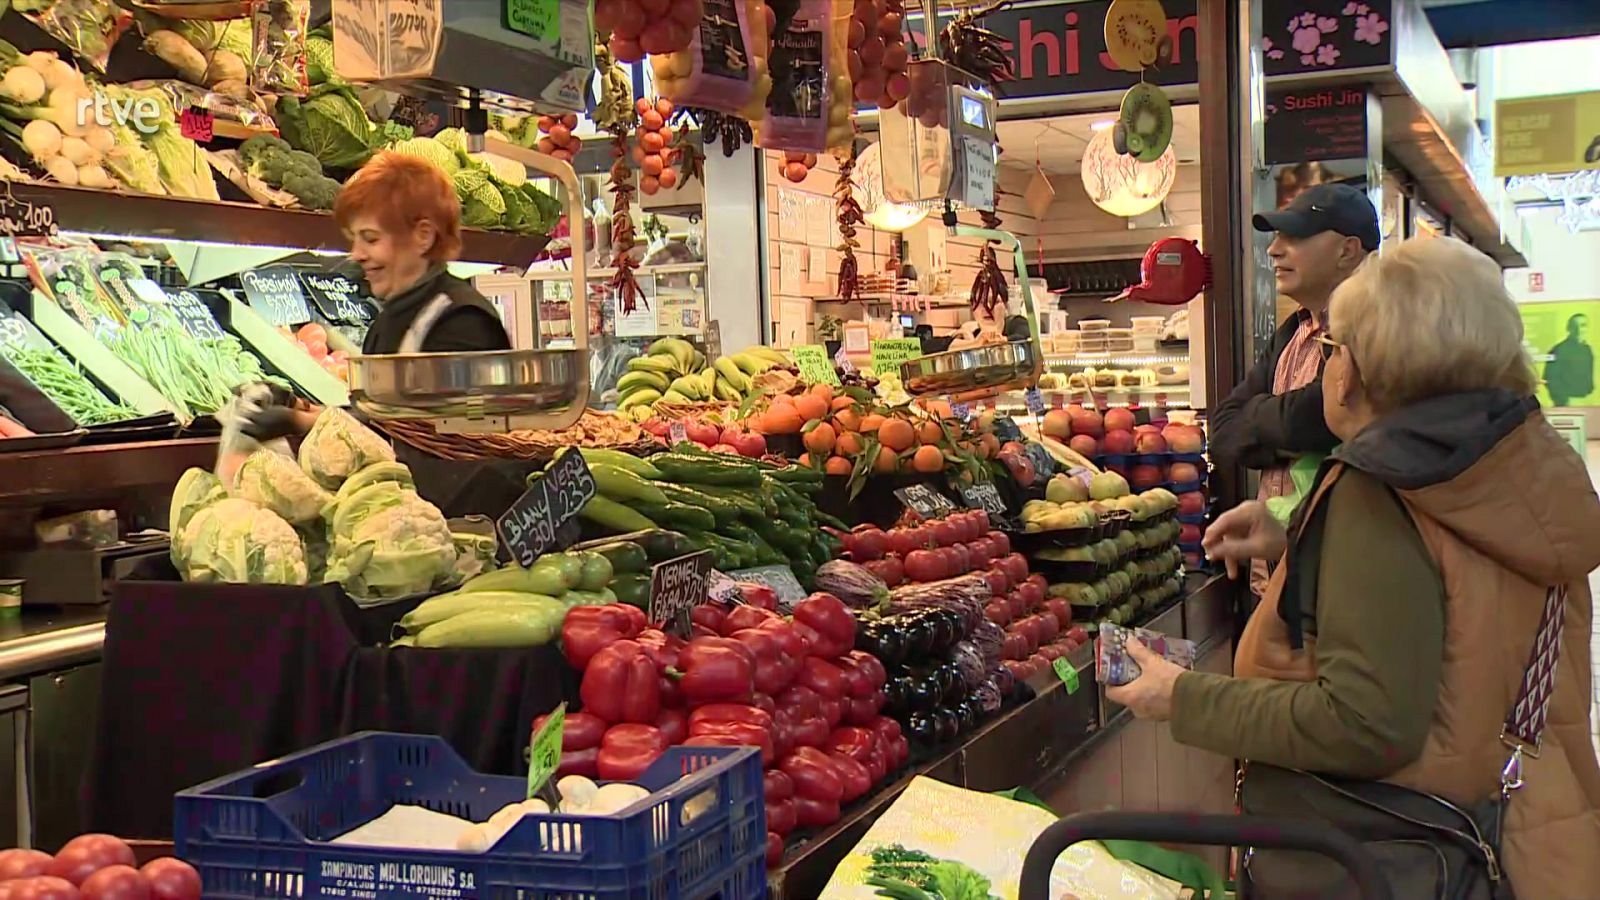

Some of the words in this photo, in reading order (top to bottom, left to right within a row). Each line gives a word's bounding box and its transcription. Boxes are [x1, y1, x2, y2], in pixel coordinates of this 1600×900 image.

[1284, 92, 1333, 111] Sushi
[1336, 89, 1363, 106] Jin
[379, 862, 456, 889] MALLORQUINS
